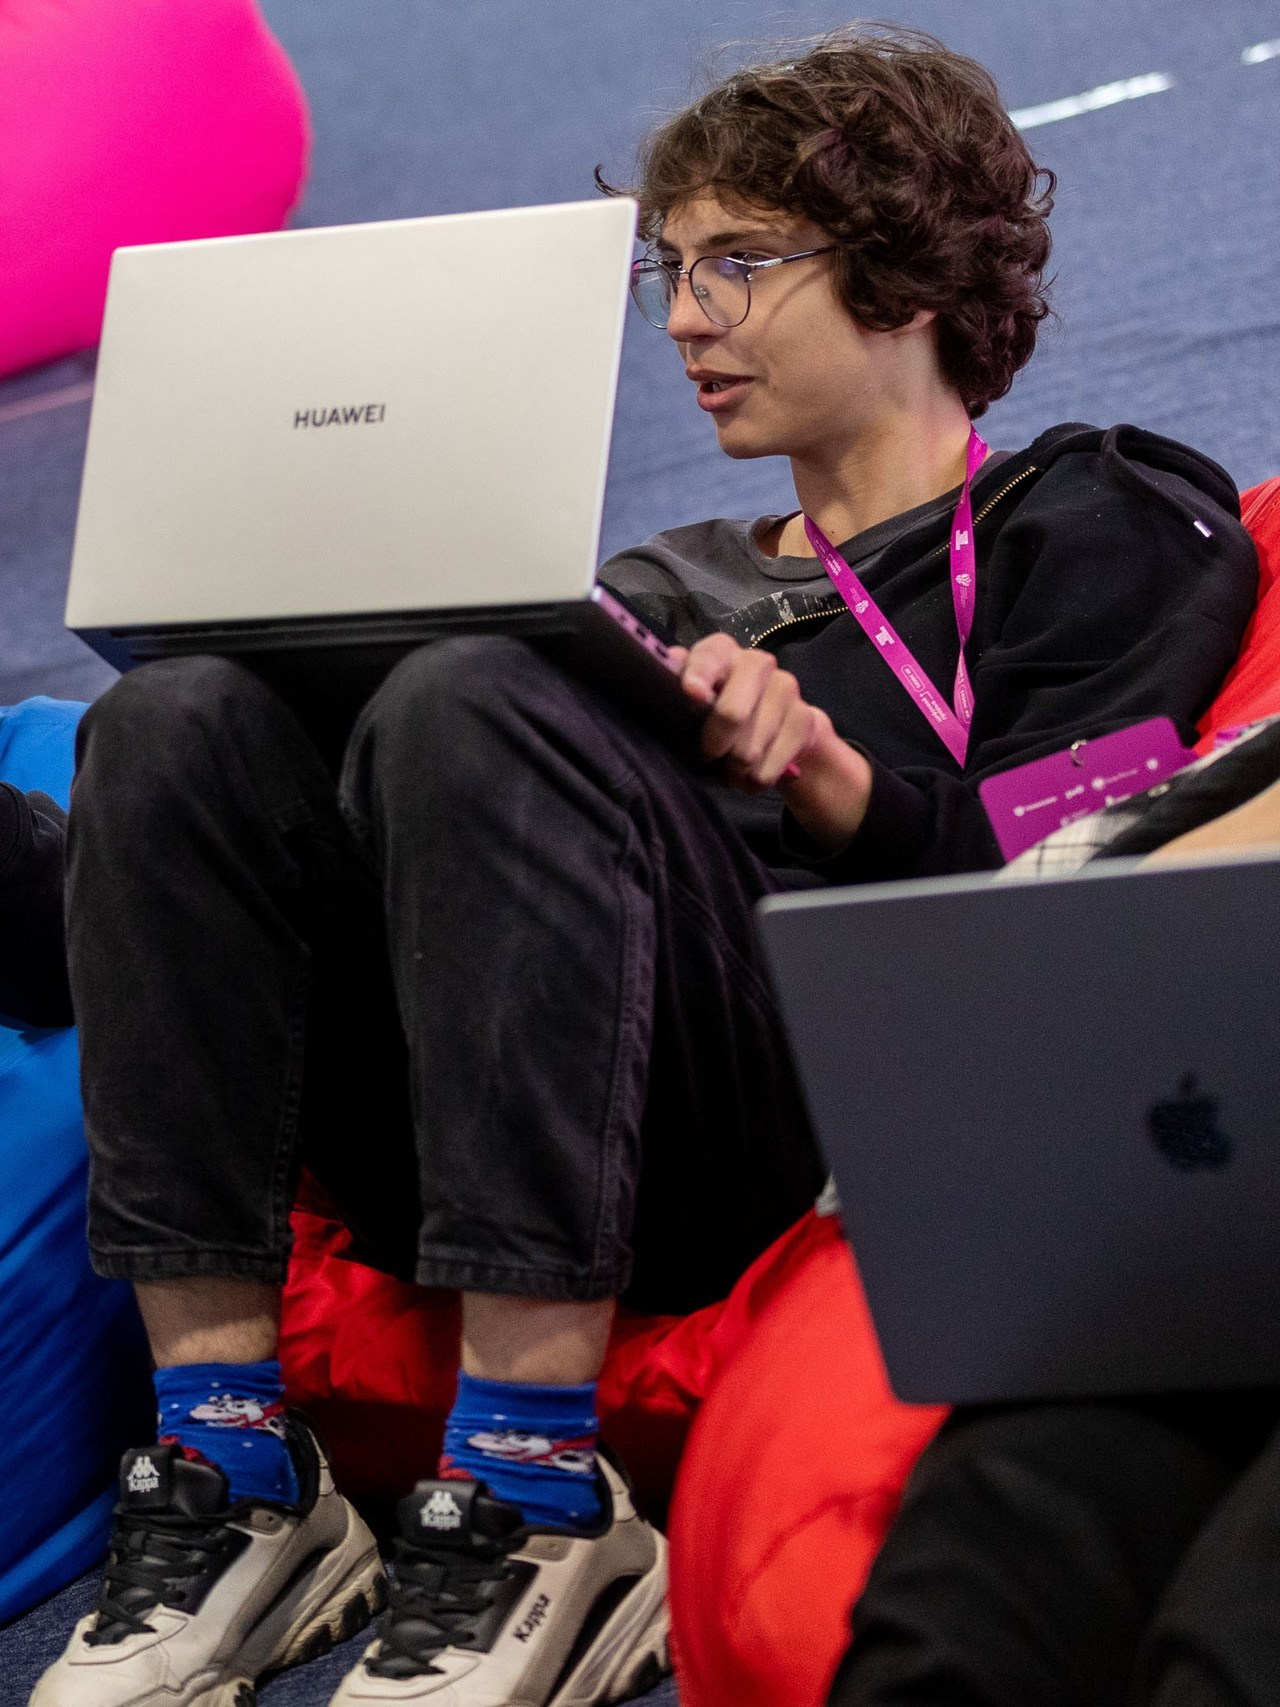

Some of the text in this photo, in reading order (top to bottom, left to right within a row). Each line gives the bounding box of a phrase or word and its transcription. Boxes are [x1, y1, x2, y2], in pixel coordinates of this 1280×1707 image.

[293, 402, 386, 429] HUAWEI
[128, 1476, 160, 1493] Kappa
[513, 1593, 550, 1643] Kappa
